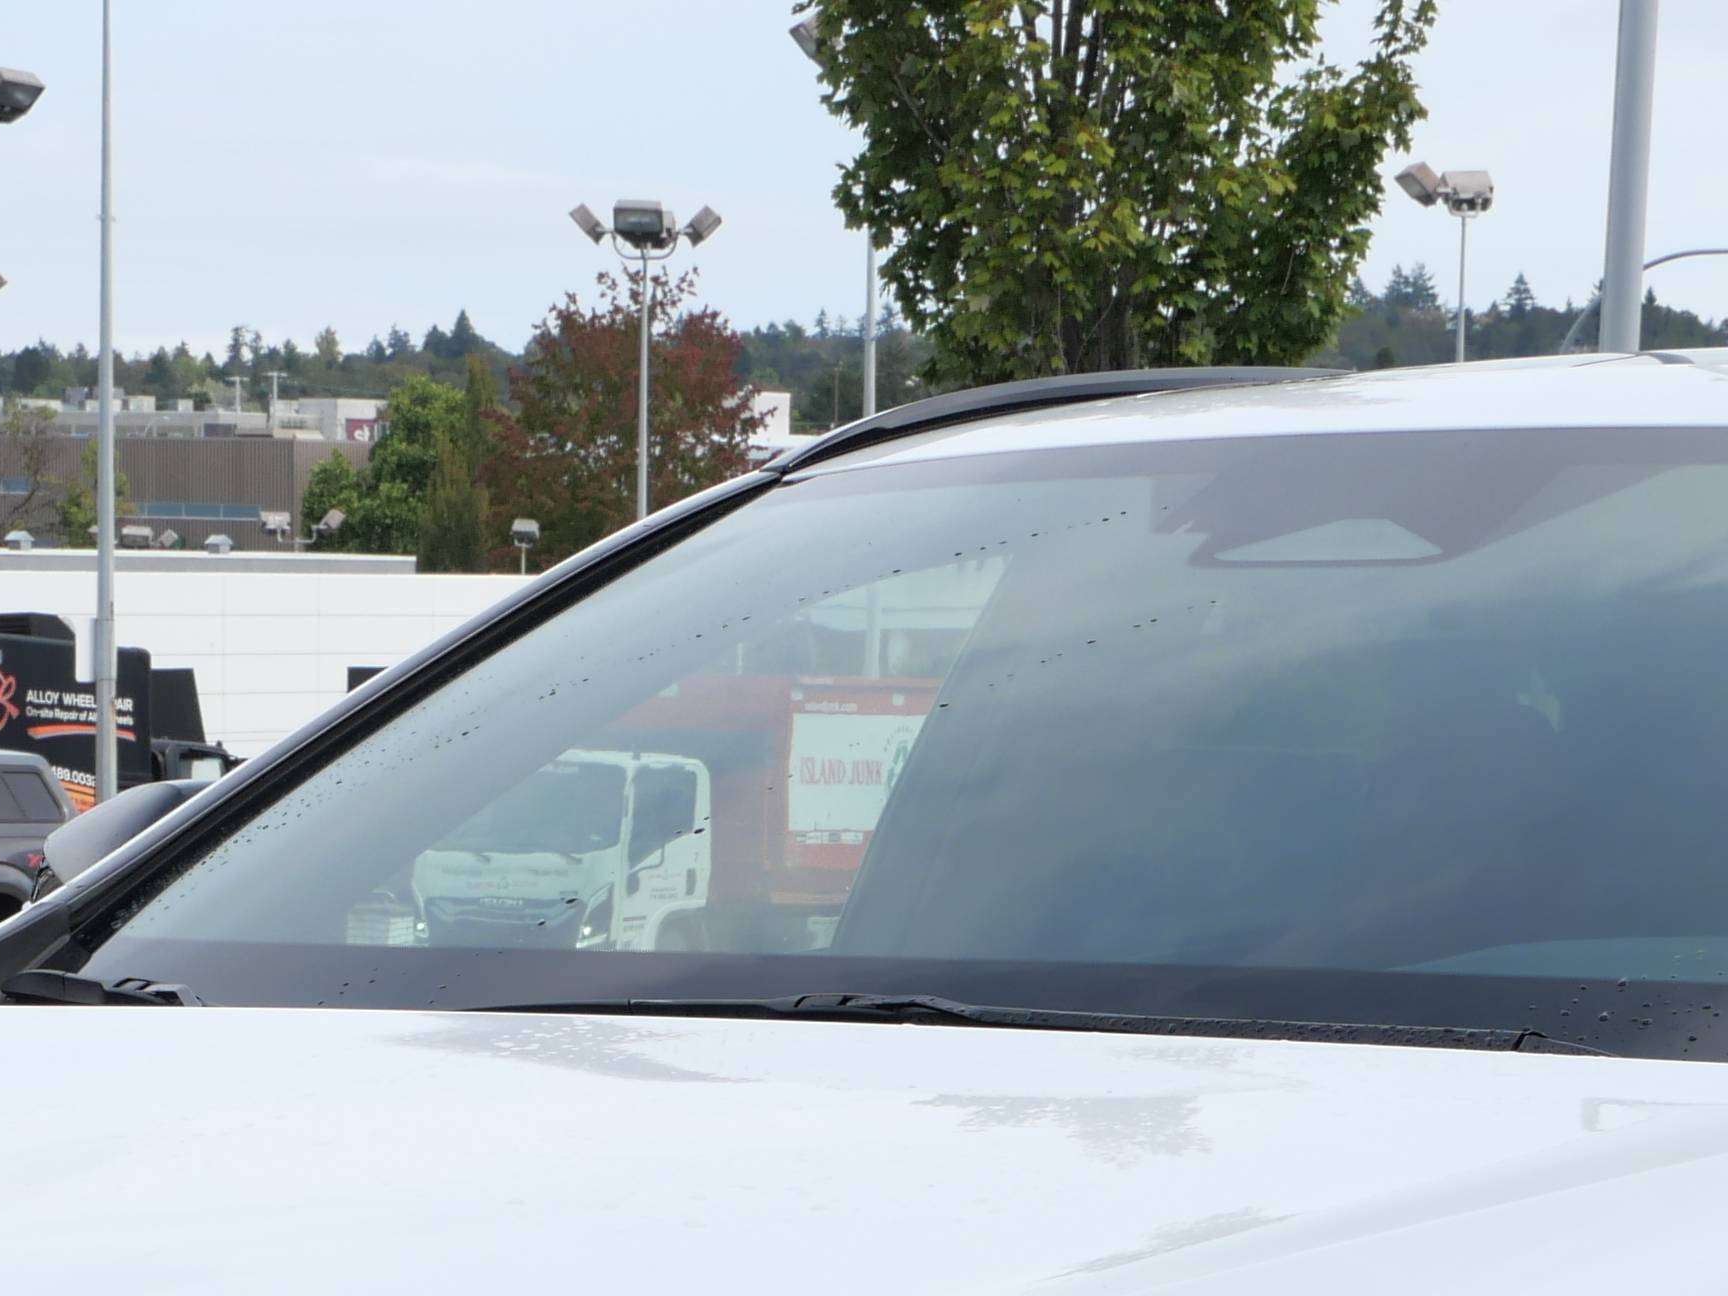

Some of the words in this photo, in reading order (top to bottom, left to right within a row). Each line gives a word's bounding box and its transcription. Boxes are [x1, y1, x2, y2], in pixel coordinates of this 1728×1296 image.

[26, 689, 60, 705] ALLOY
[63, 693, 98, 708] WHEEL
[54, 709, 78, 722] Repair
[79, 711, 88, 721] of
[798, 756, 847, 785] ISLAND
[848, 759, 884, 786] JUNK
